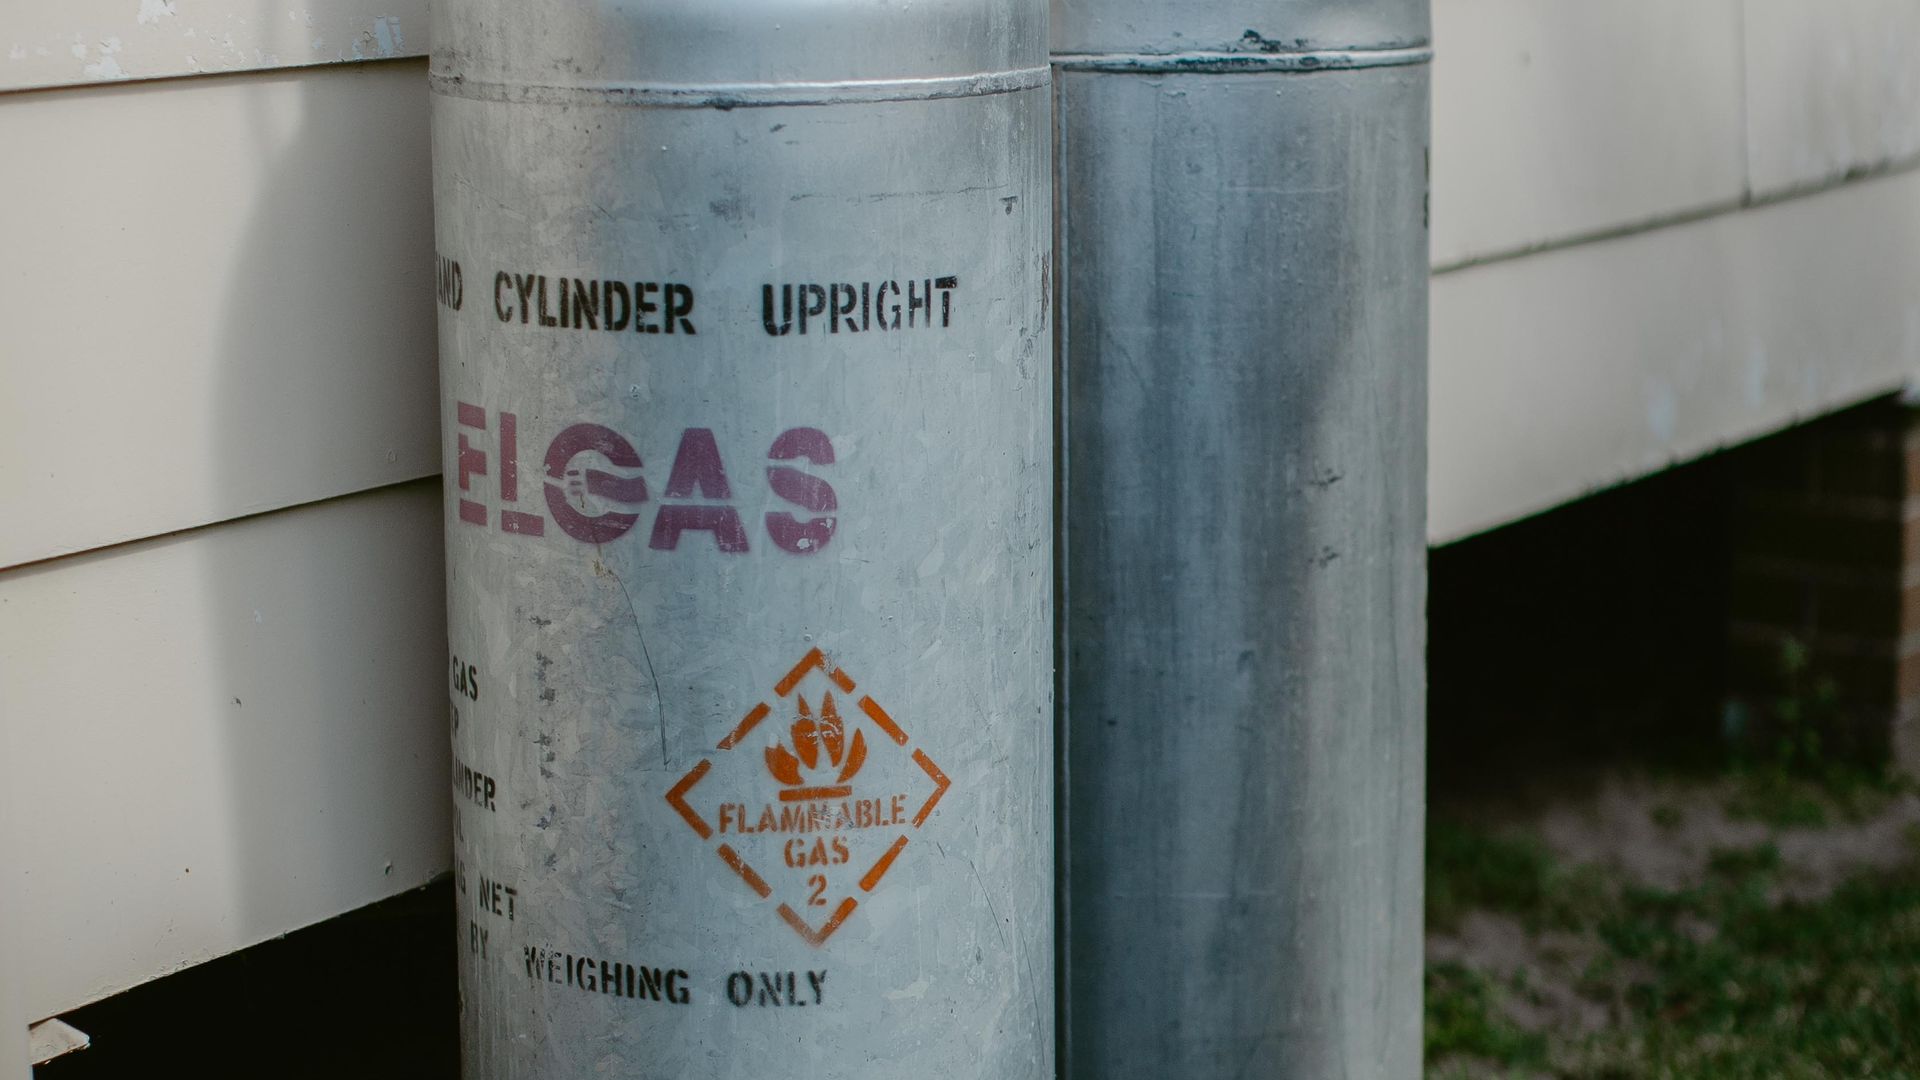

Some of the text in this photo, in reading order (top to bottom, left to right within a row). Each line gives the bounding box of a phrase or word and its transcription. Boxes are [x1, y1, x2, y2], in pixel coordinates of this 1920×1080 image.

[494, 270, 697, 335] CYLINDER
[762, 276, 958, 337] UPRIGHT
[457, 401, 838, 555] ELGAS
[453, 655, 478, 701] GAS
[718, 794, 908, 834] FLAMMABLE
[784, 836, 850, 868] GAS
[479, 872, 518, 921] NET
[807, 874, 827, 906] 2
[470, 919, 828, 1007] BY WEIGHING ONLY
